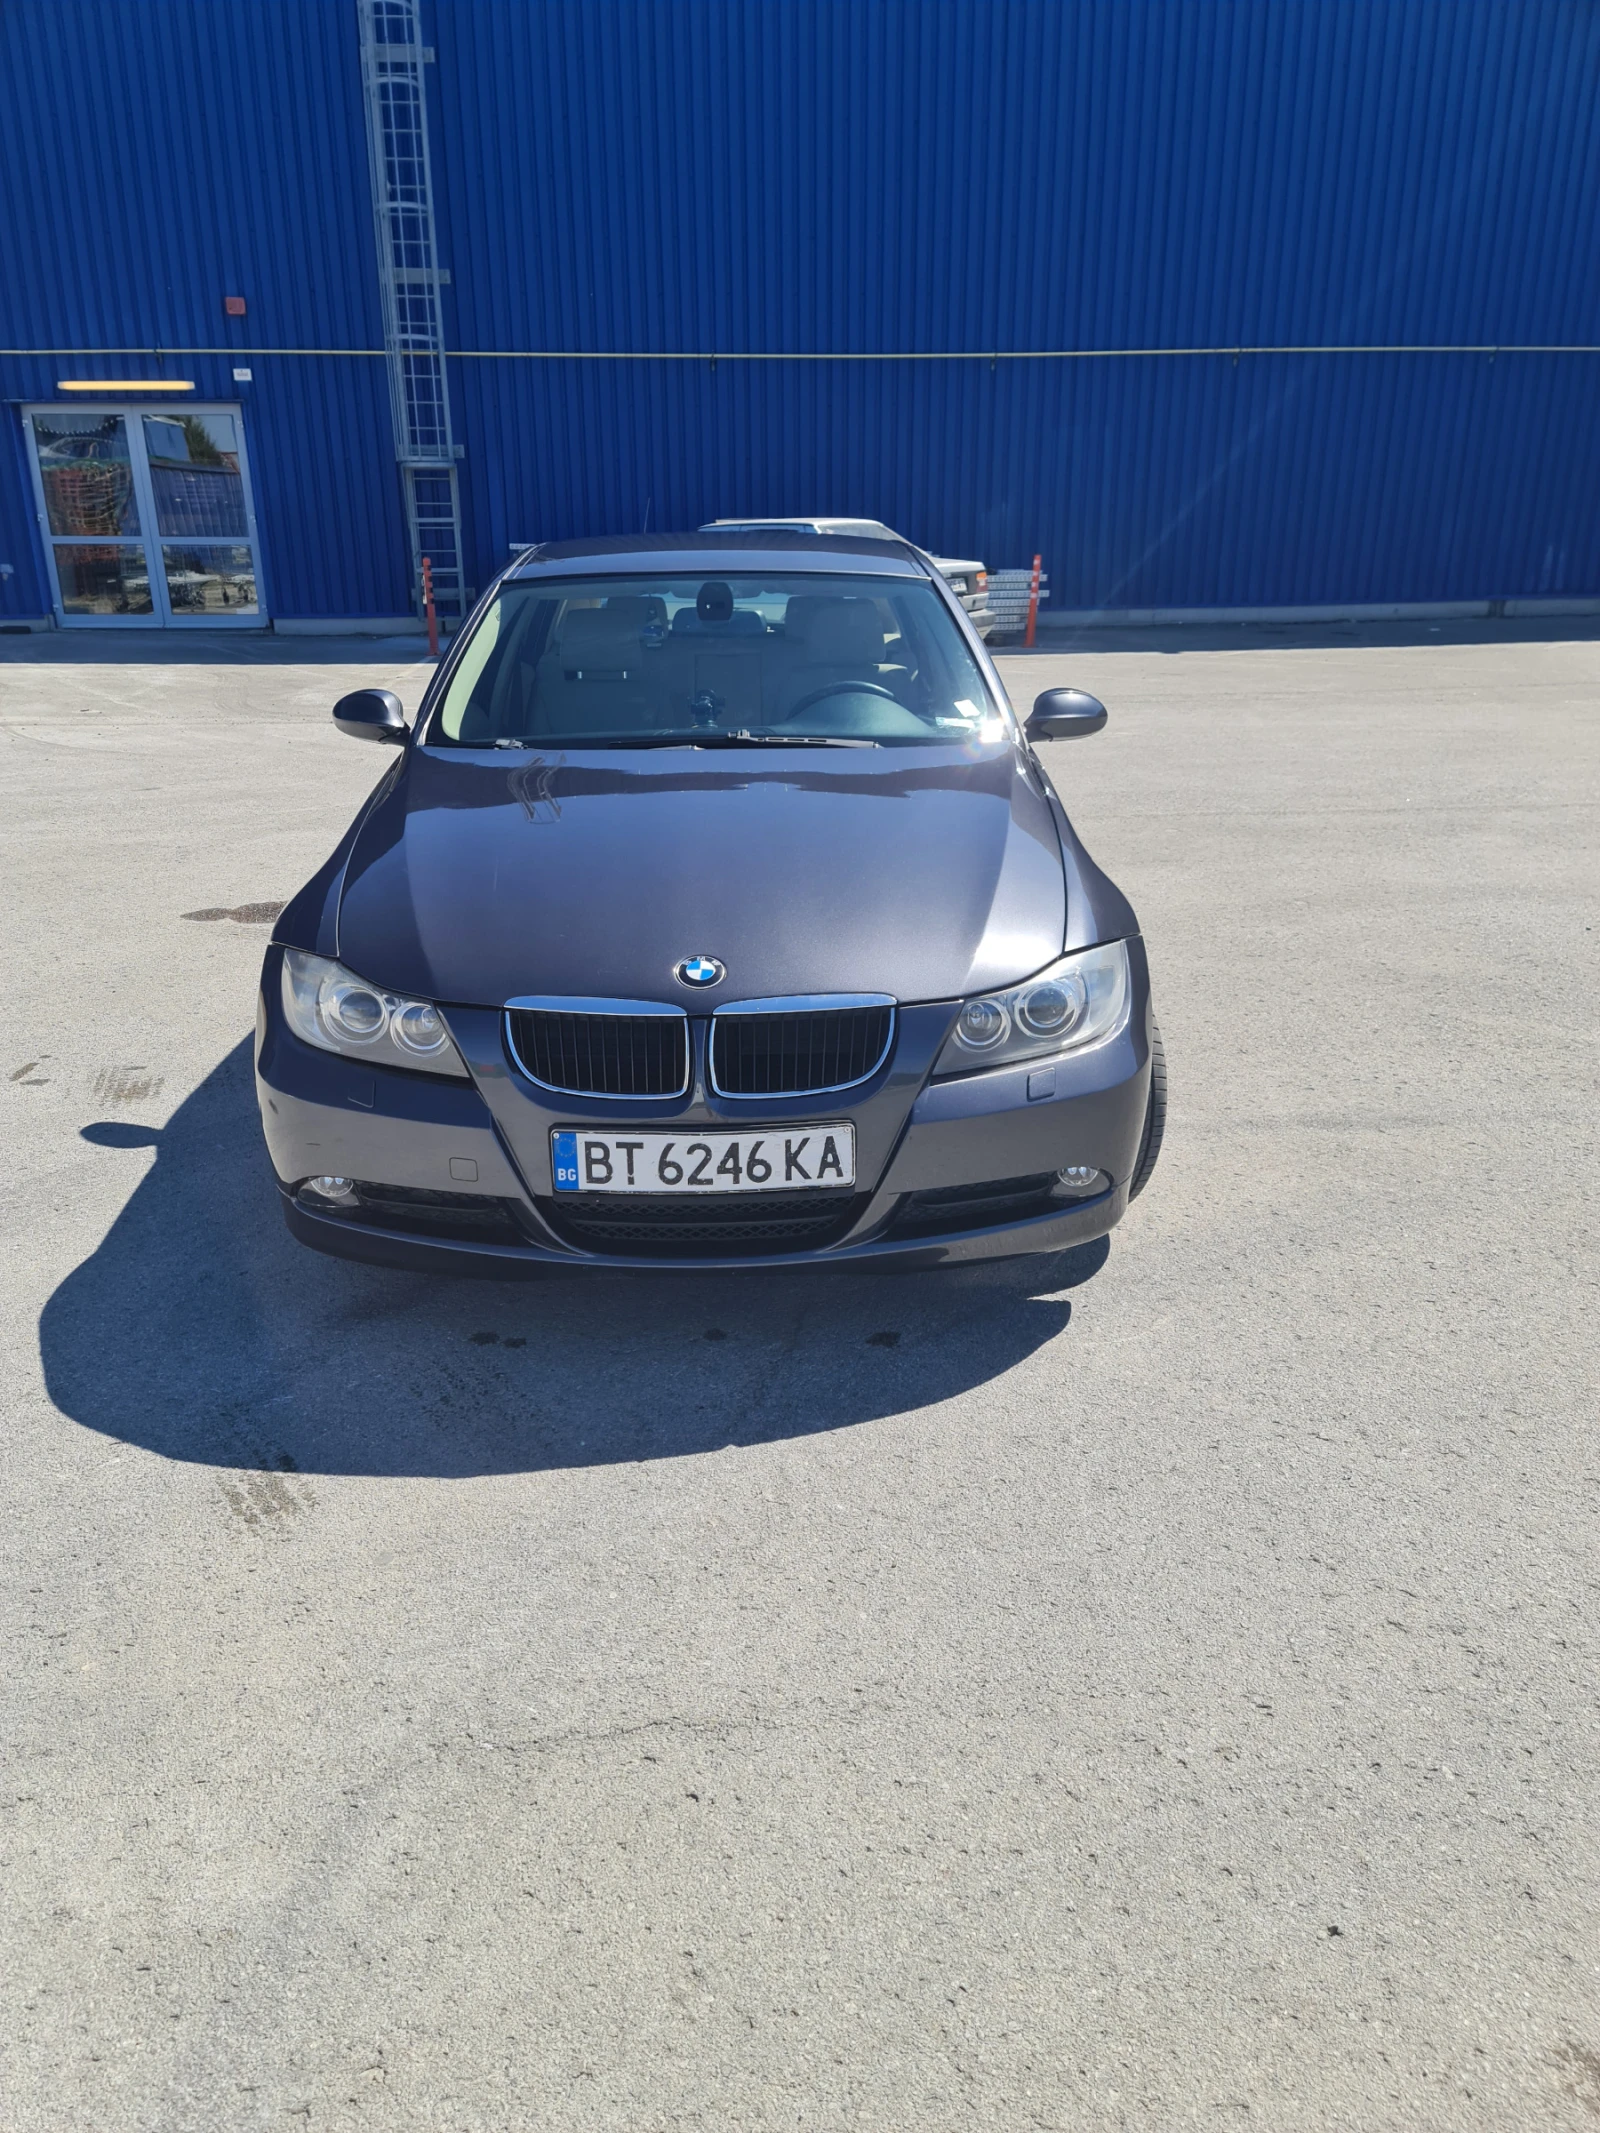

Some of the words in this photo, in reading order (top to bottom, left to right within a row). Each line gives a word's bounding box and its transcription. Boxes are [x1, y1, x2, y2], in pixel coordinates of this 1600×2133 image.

[557, 1167, 577, 1181] BG
[584, 1140, 645, 1186] BT
[657, 1140, 773, 1186] 6246
[784, 1135, 845, 1182] KA
